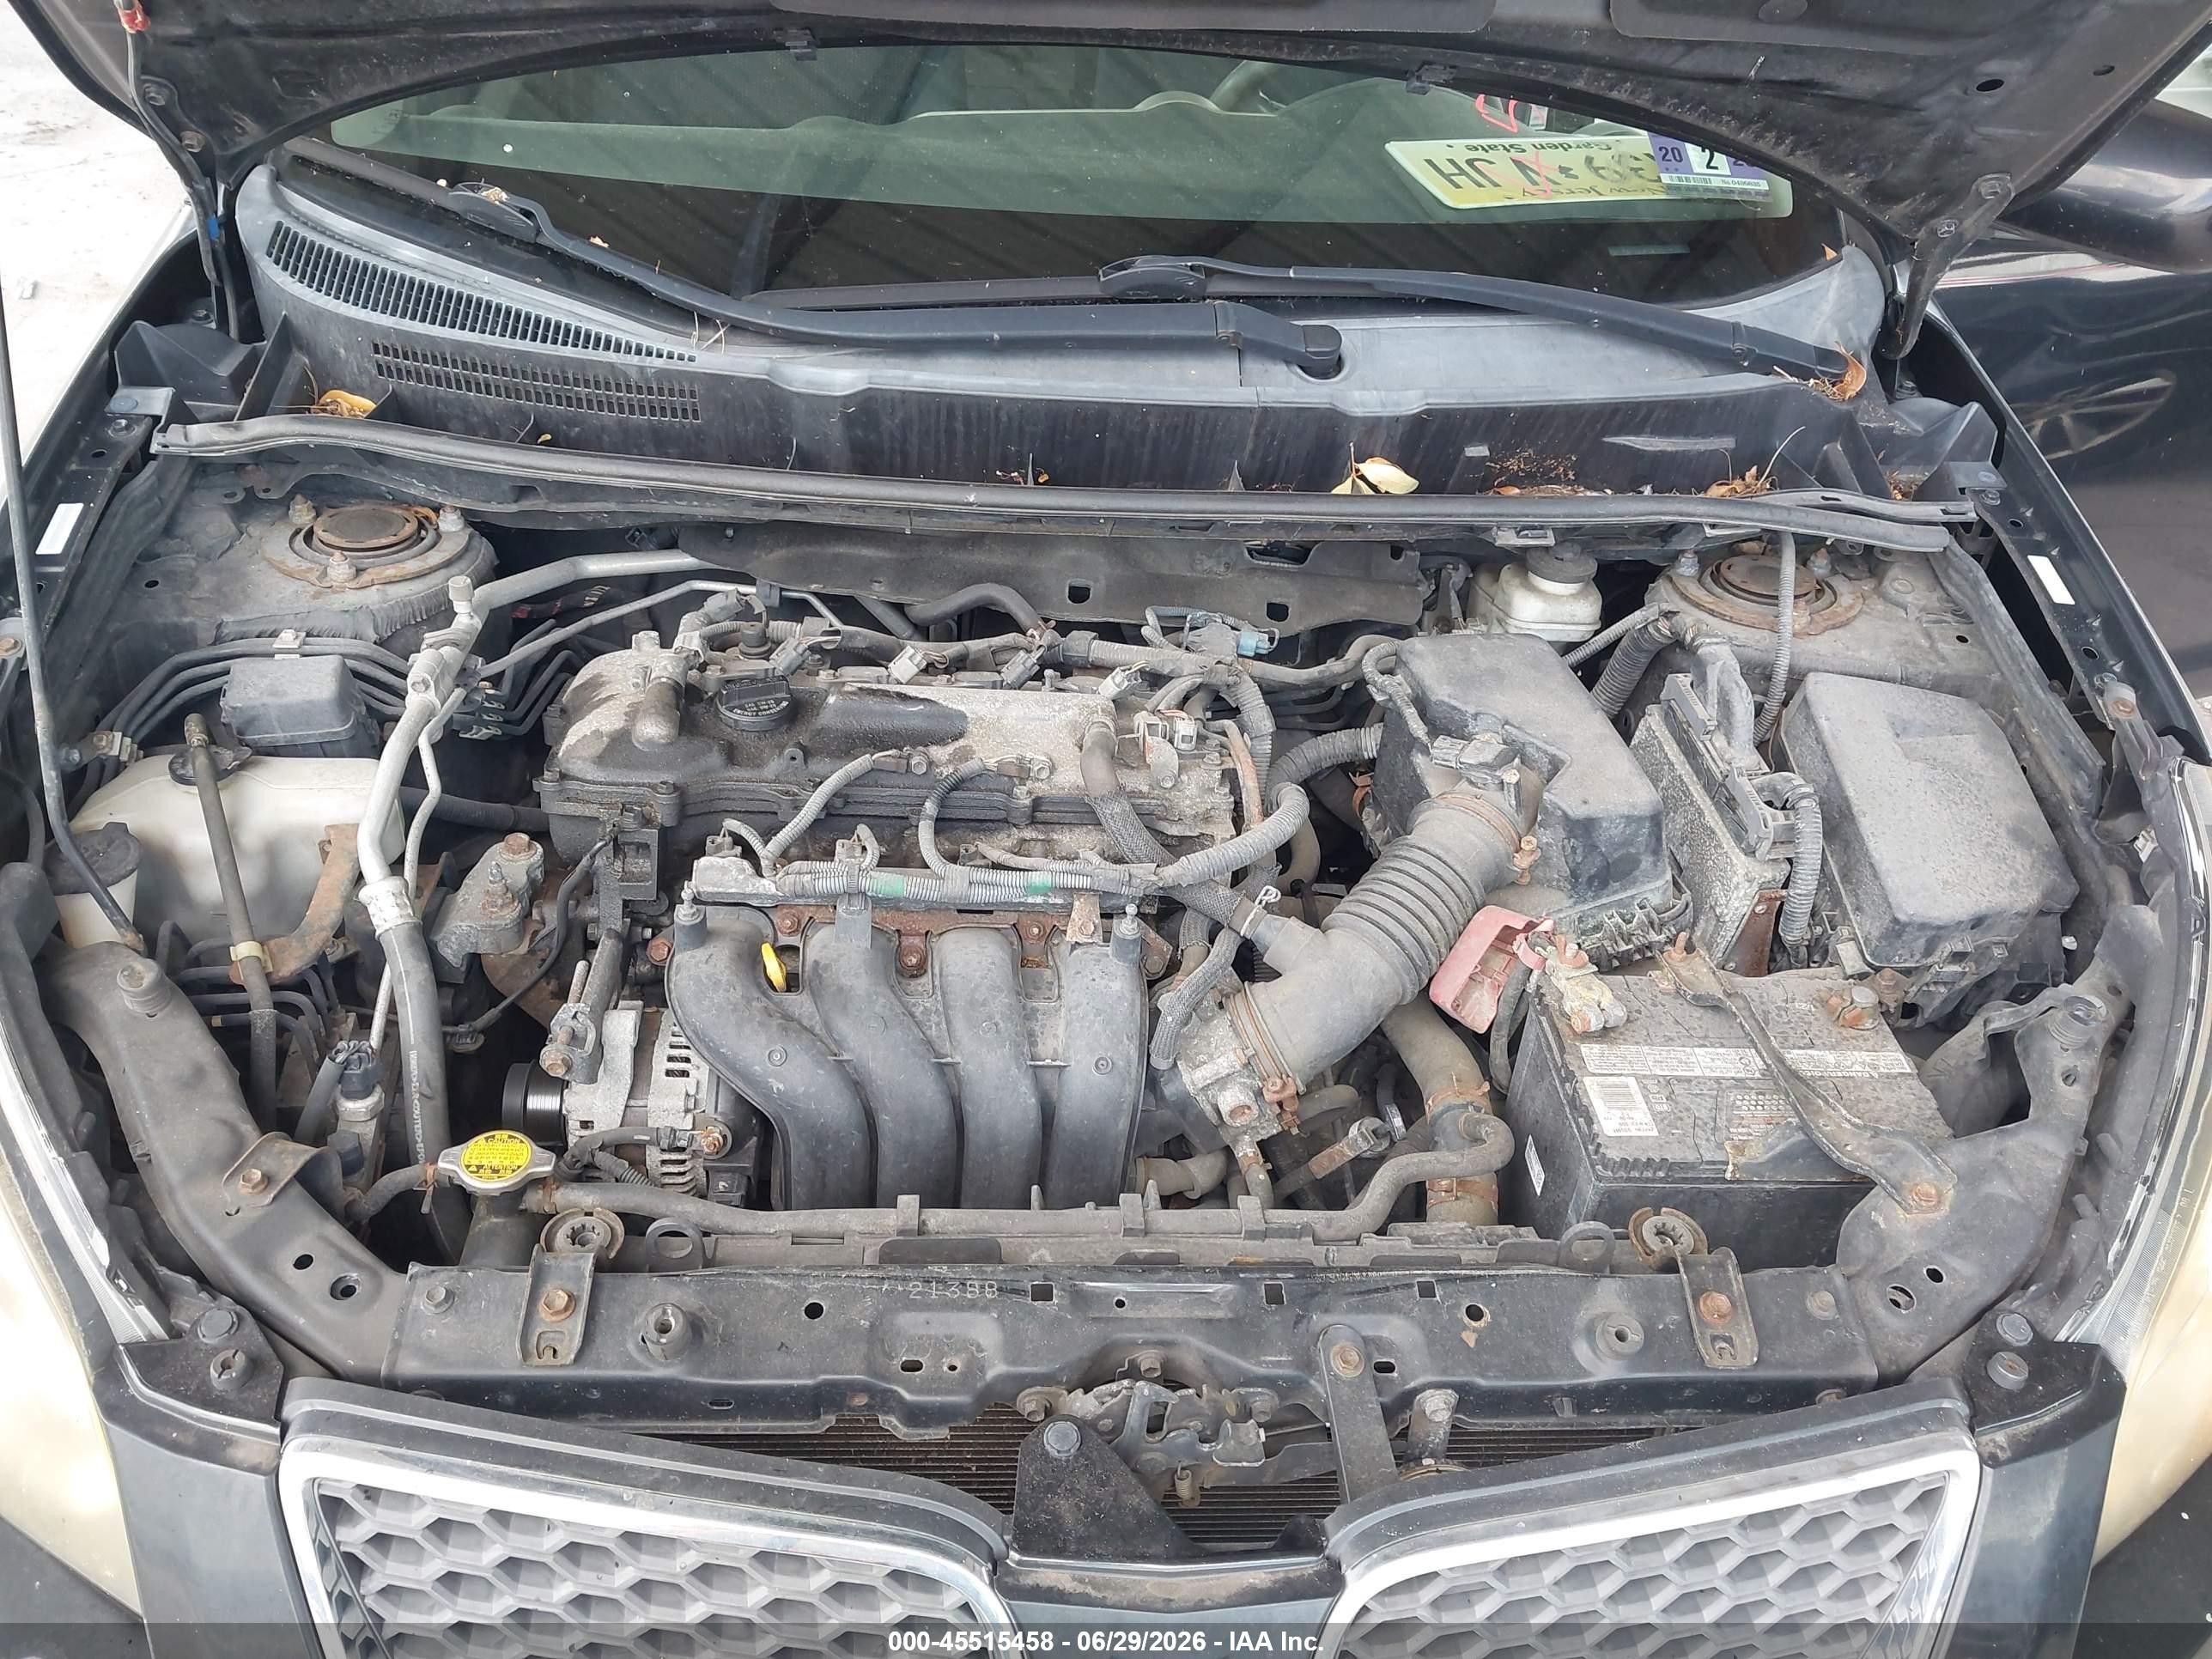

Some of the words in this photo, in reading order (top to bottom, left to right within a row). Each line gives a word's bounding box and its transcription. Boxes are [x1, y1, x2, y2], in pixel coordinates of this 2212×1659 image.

[1465, 143, 1527, 154] State
[1533, 142, 1612, 152] Garden
[1658, 146, 1684, 163] 20
